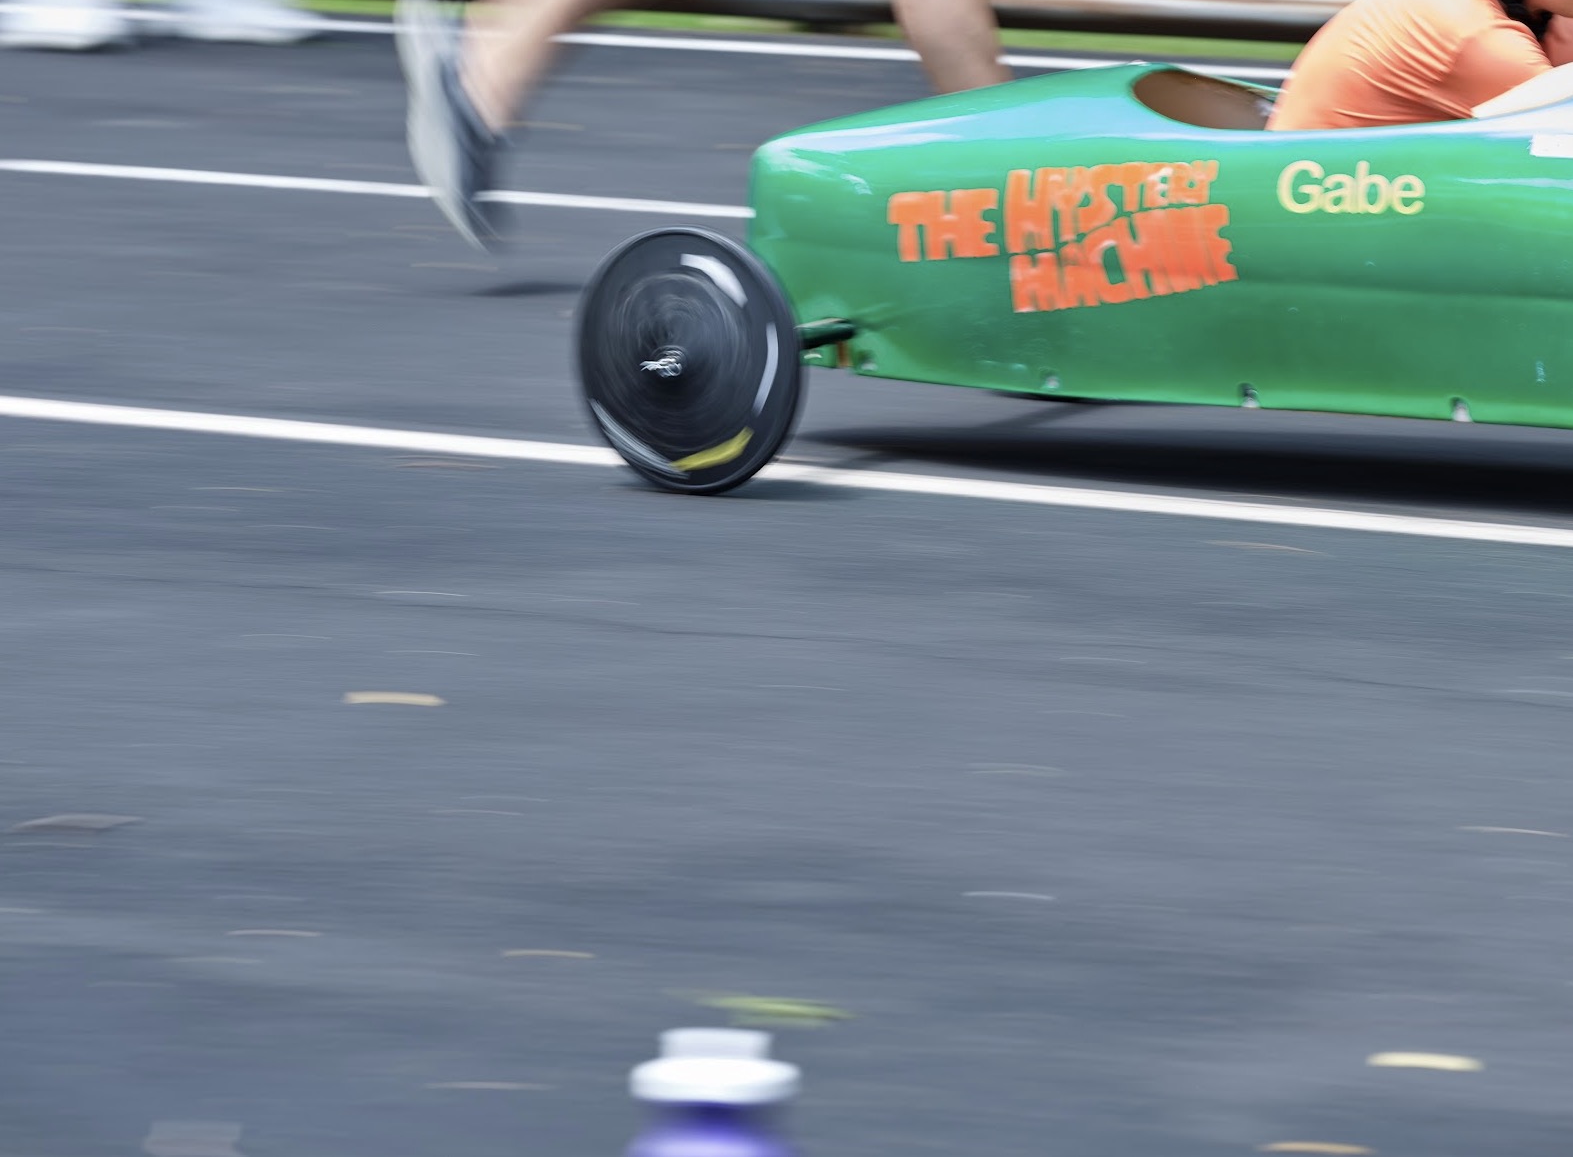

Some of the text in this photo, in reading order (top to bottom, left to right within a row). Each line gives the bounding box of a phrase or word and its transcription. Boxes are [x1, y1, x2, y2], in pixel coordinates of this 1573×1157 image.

[887, 160, 1219, 262] THE MYSTERY
[1276, 159, 1426, 215] Gabe
[1009, 204, 1240, 313] MACHINE
